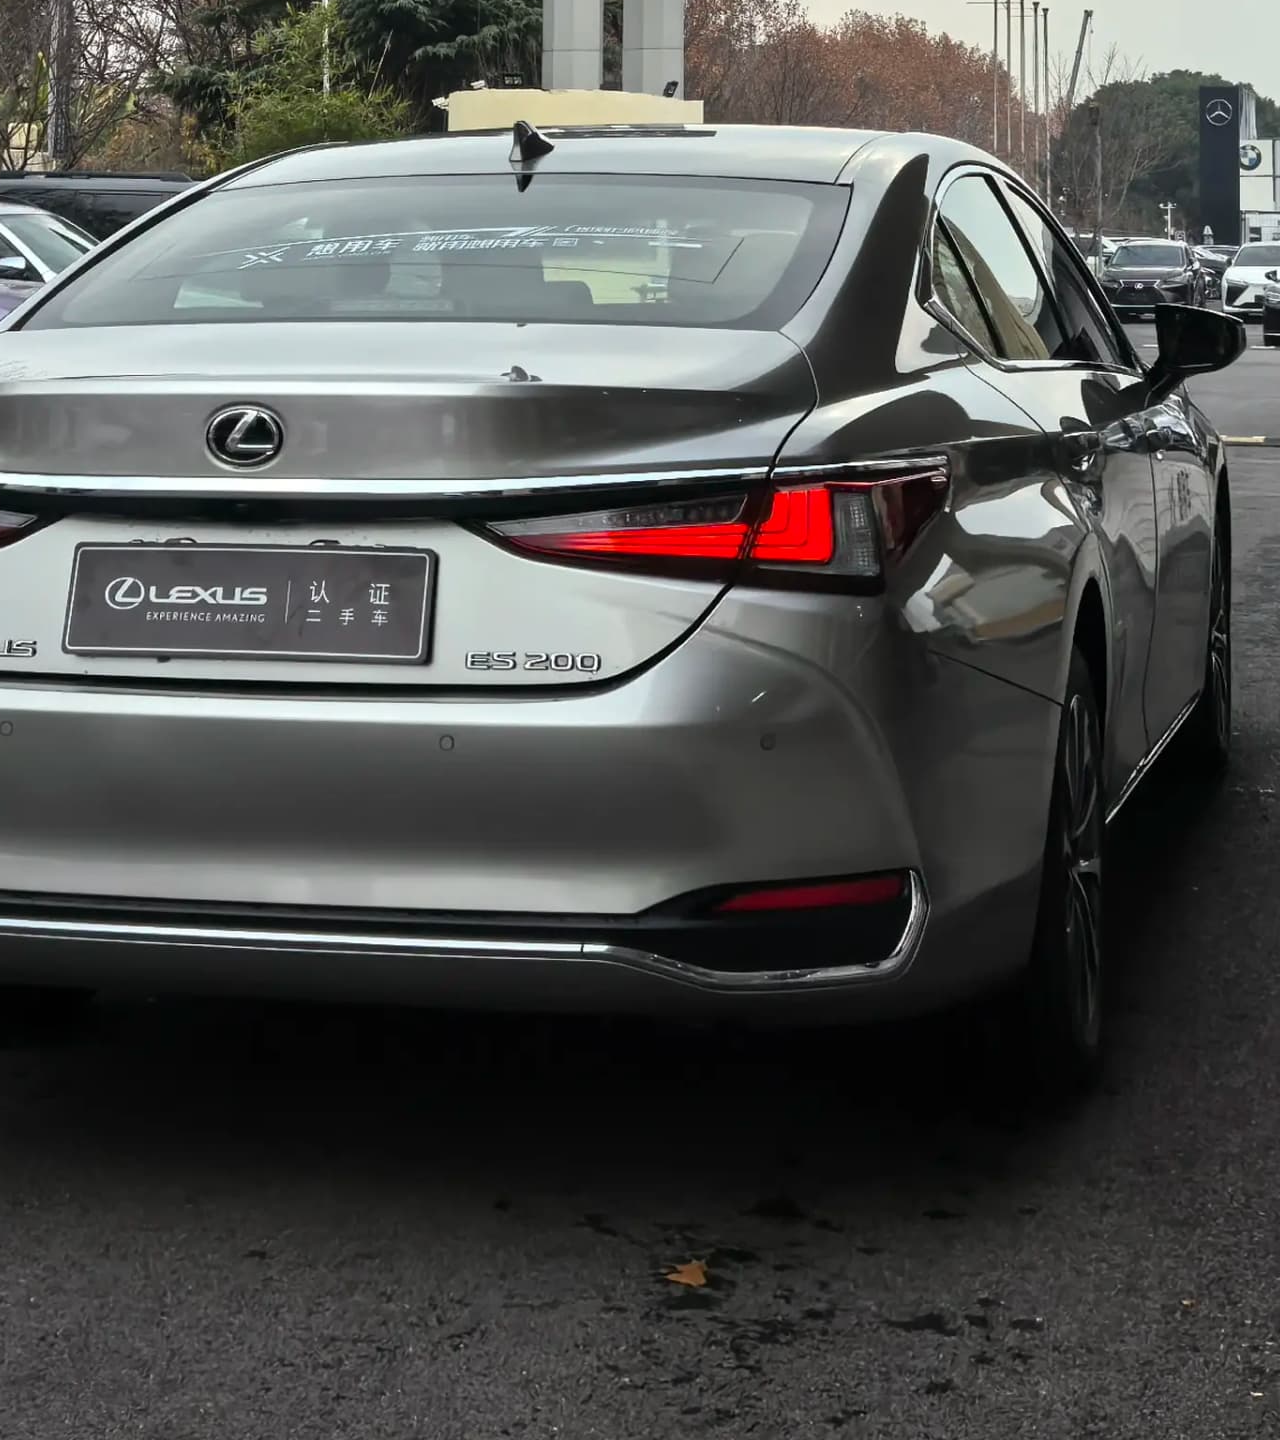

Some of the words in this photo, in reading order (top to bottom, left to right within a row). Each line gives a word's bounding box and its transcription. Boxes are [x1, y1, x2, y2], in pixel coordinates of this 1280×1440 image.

[149, 586, 268, 605] LEXUS
[309, 580, 391, 605] 认证
[146, 611, 211, 622] EXPERIENCE
[215, 613, 265, 623] AMAZING
[305, 608, 389, 627] 二手车
[465, 651, 517, 671] ES
[523, 651, 602, 674] 200
